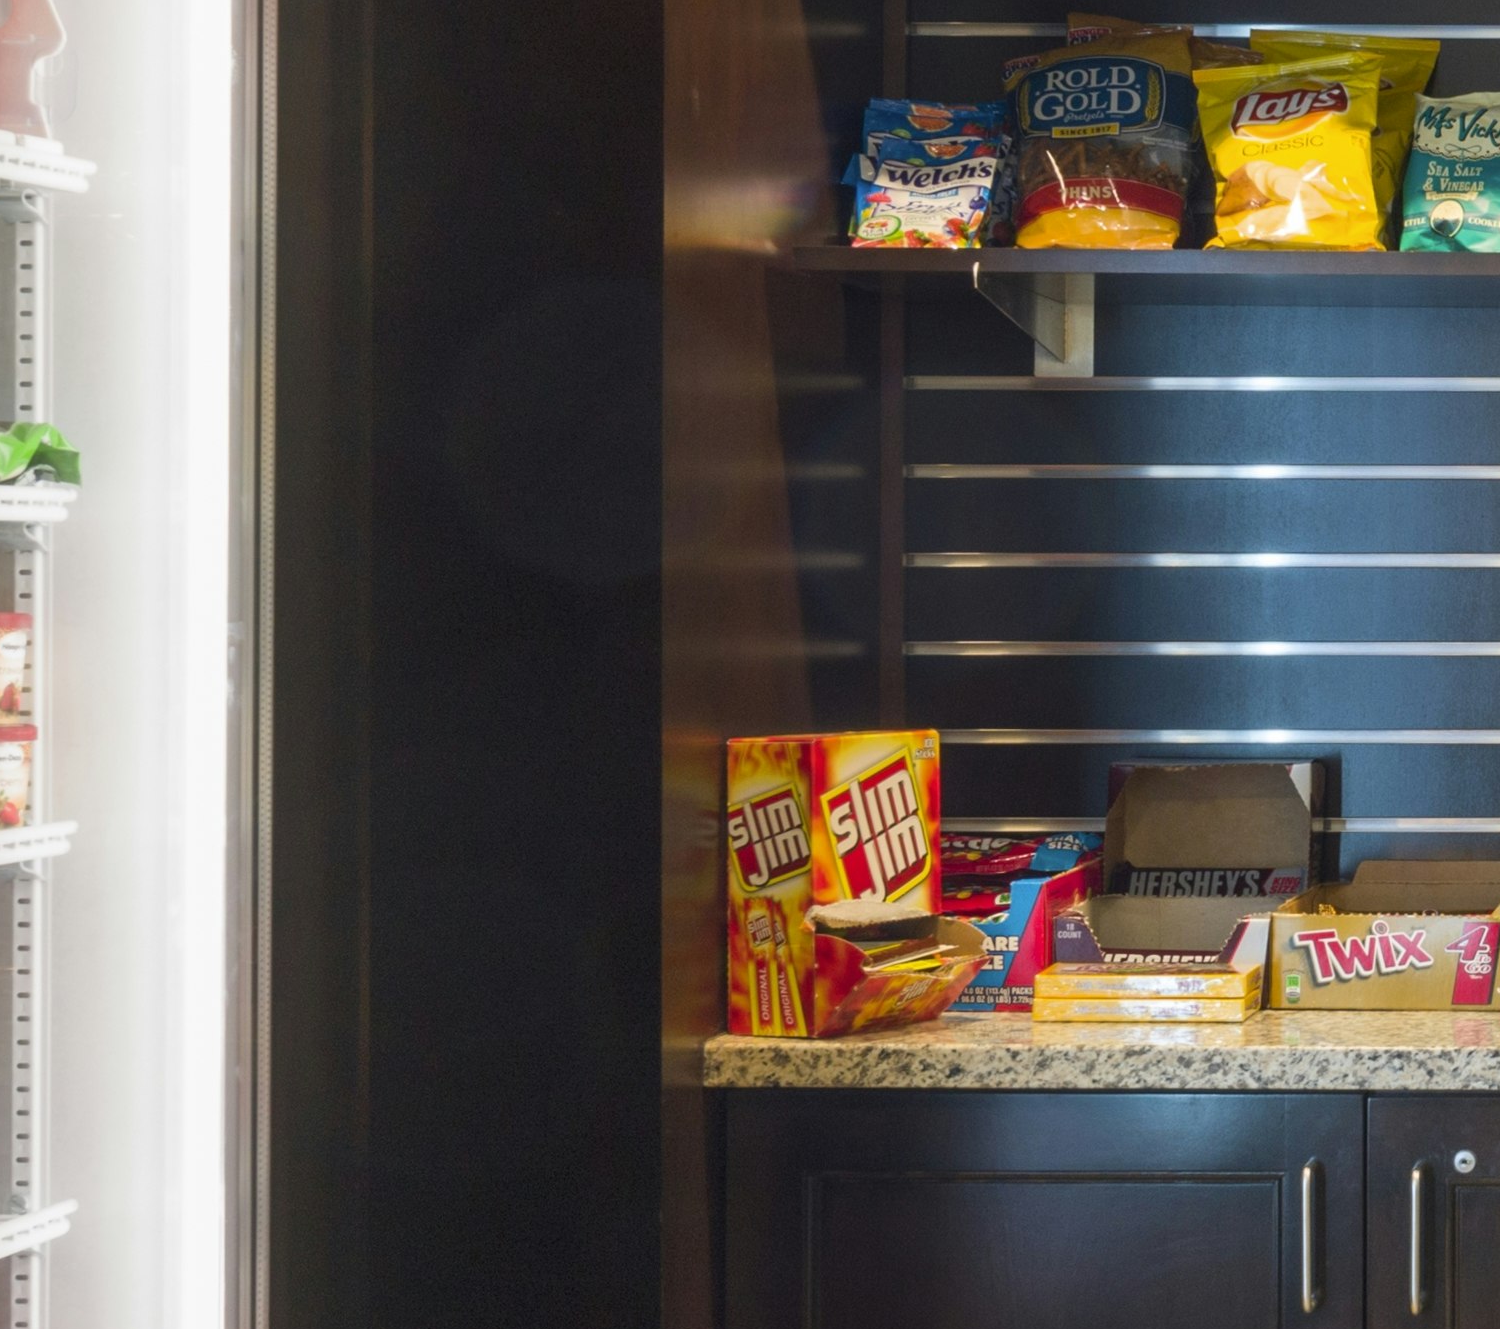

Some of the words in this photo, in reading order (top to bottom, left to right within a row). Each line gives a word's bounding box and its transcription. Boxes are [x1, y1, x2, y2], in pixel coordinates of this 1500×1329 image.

[1044, 65, 1137, 92] ROLD
[1033, 88, 1141, 121] GOLD
[1237, 83, 1346, 126] Lay's
[1059, 128, 1088, 136] SINCE
[1242, 134, 1324, 157] Classic
[886, 158, 993, 188] Welch's
[1440, 178, 1485, 192] VINEGAR
[1129, 870, 1262, 897] HERSHEY'S
[1269, 885, 1298, 893] SIZE
[1271, 876, 1301, 887] KING
[1058, 930, 1082, 939] COUNT
[1066, 923, 1075, 931] 18
[779, 971, 794, 1025] ORIGINAL
[1012, 986, 1033, 996] PACKS
